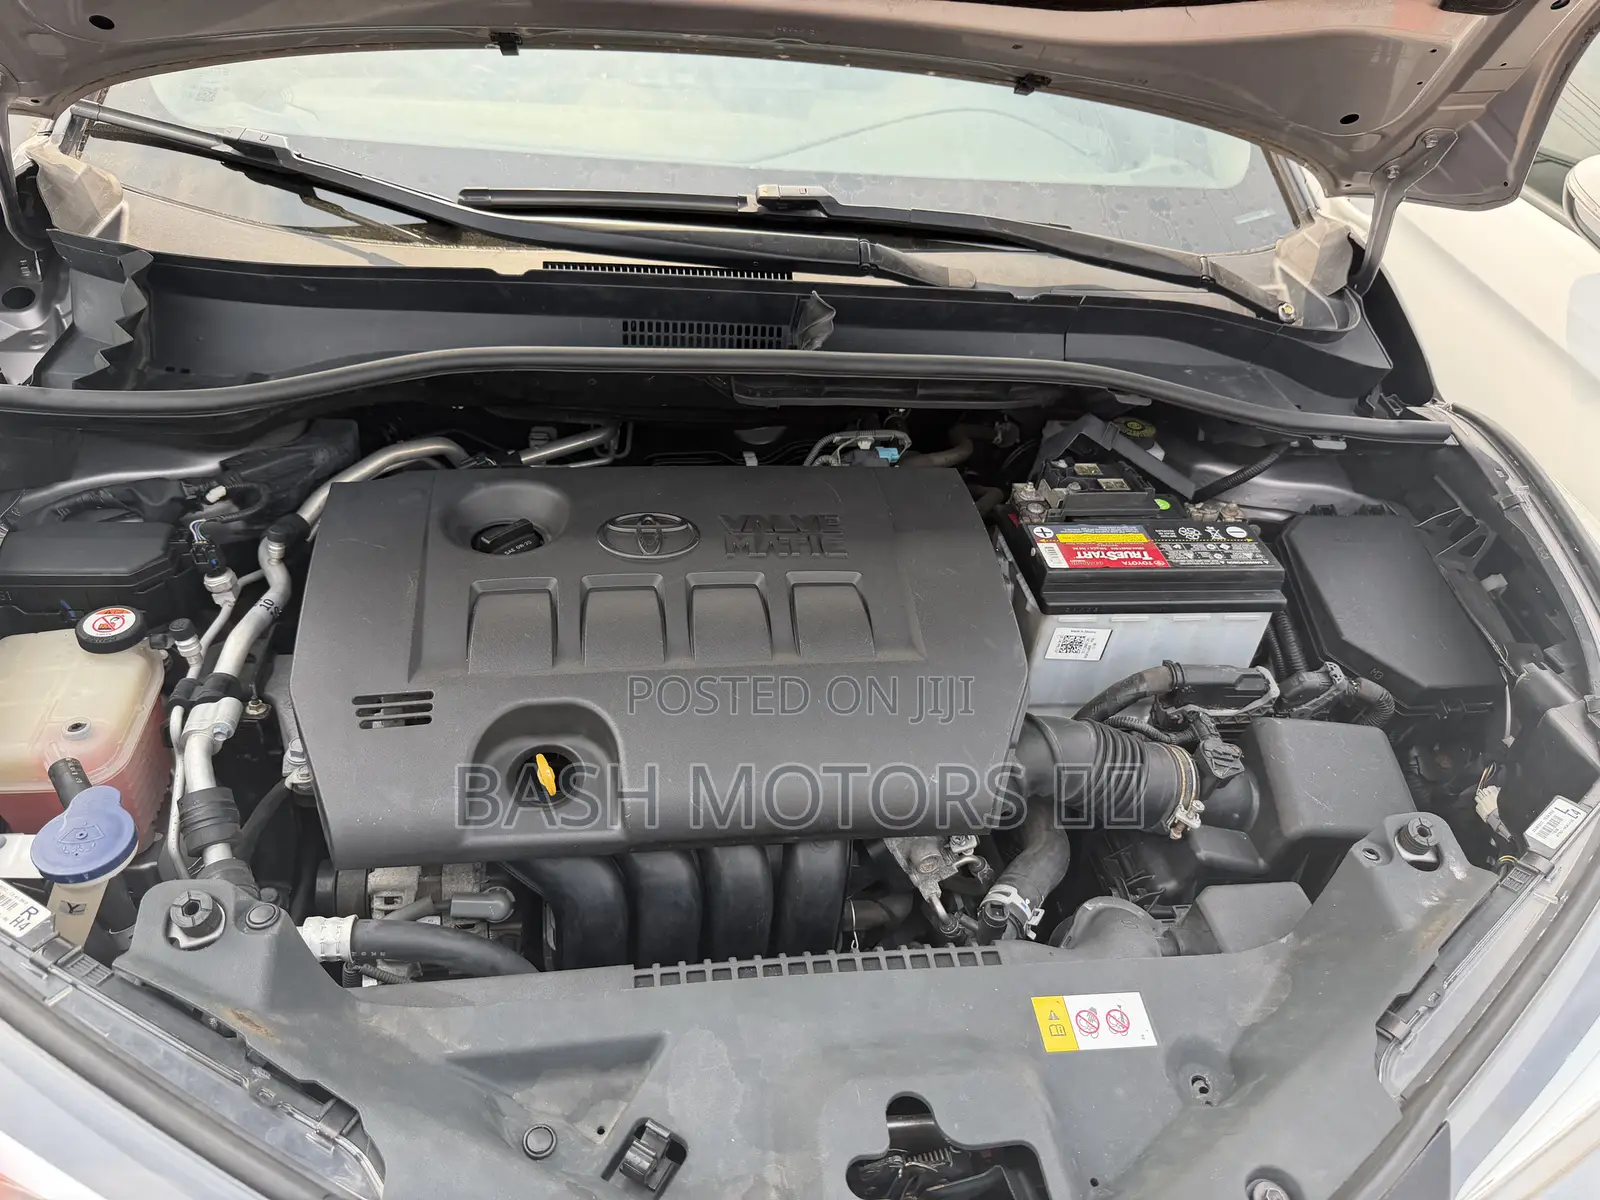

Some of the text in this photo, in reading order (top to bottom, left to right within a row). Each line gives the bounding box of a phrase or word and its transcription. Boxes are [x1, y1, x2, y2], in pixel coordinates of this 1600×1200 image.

[719, 514, 843, 535] VALVE
[725, 534, 848, 557] MATIC
[20, 906, 39, 920] R
[9, 915, 31, 931] H4
